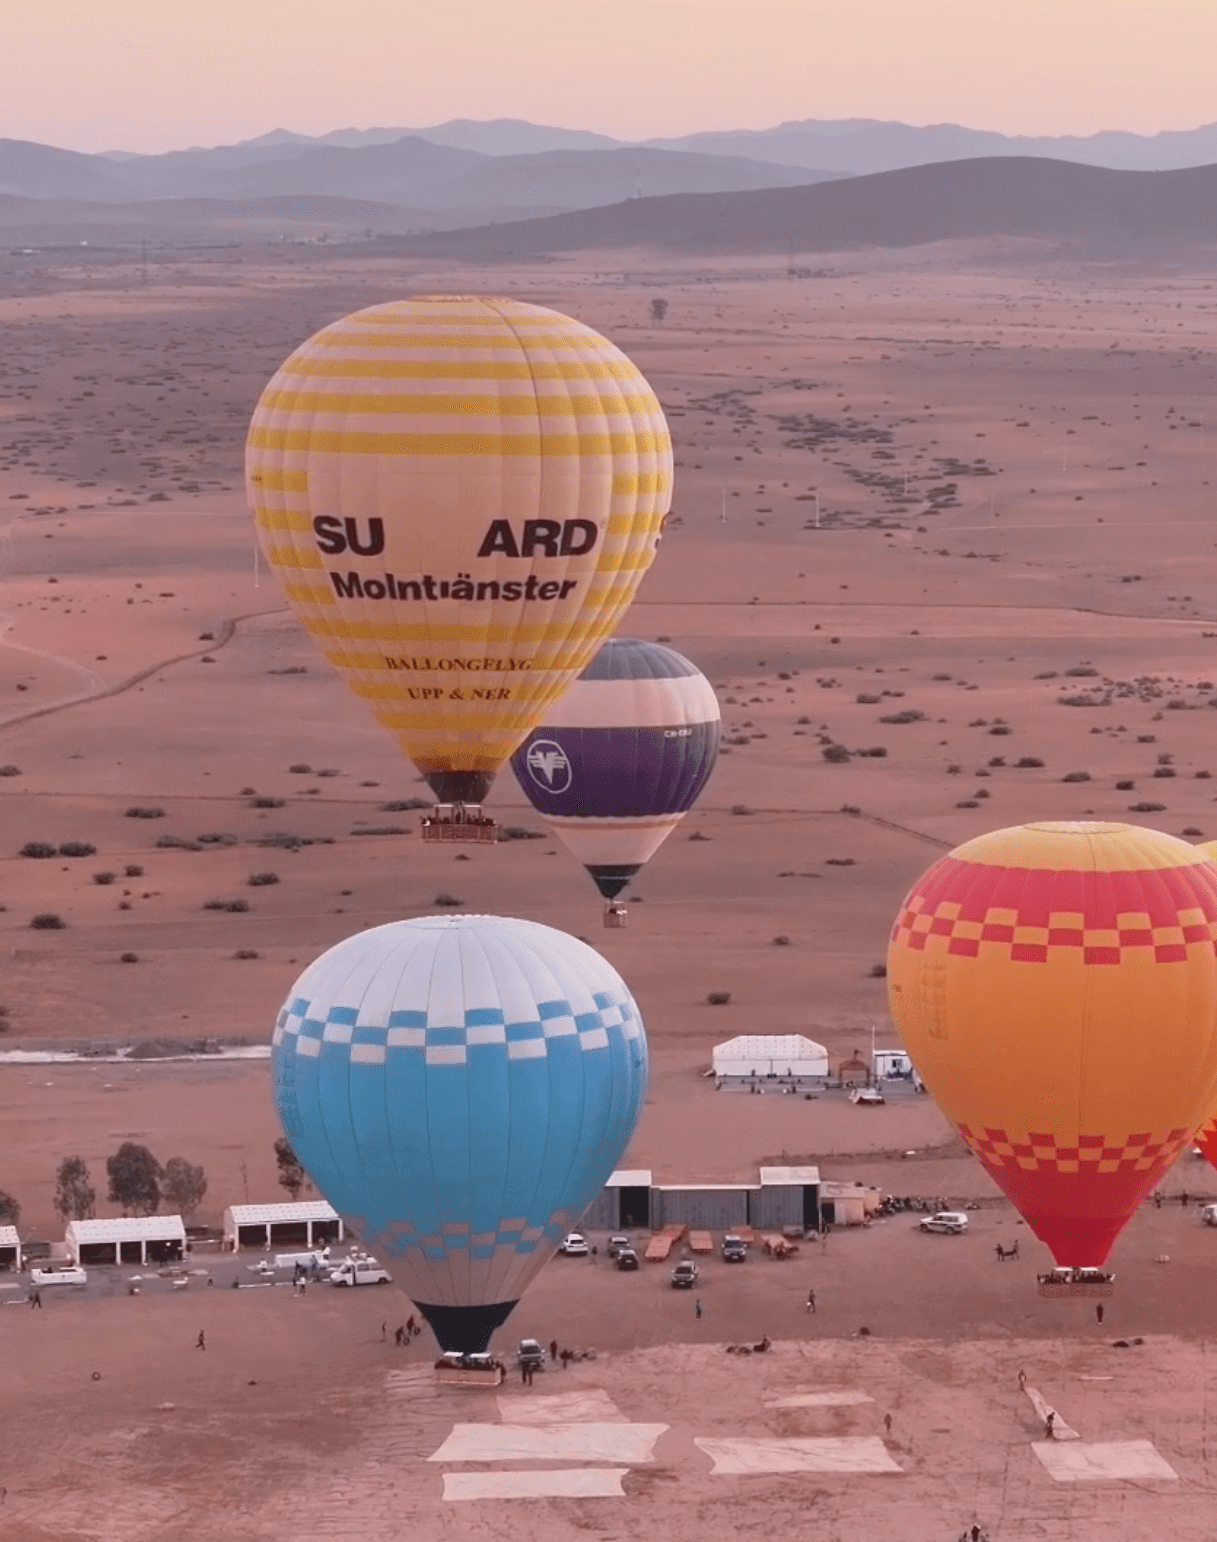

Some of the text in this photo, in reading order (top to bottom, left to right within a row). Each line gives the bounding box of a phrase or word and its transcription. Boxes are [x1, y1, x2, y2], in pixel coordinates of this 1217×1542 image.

[312, 515, 598, 558] SU ARD
[407, 687, 512, 701] UPP & NER
